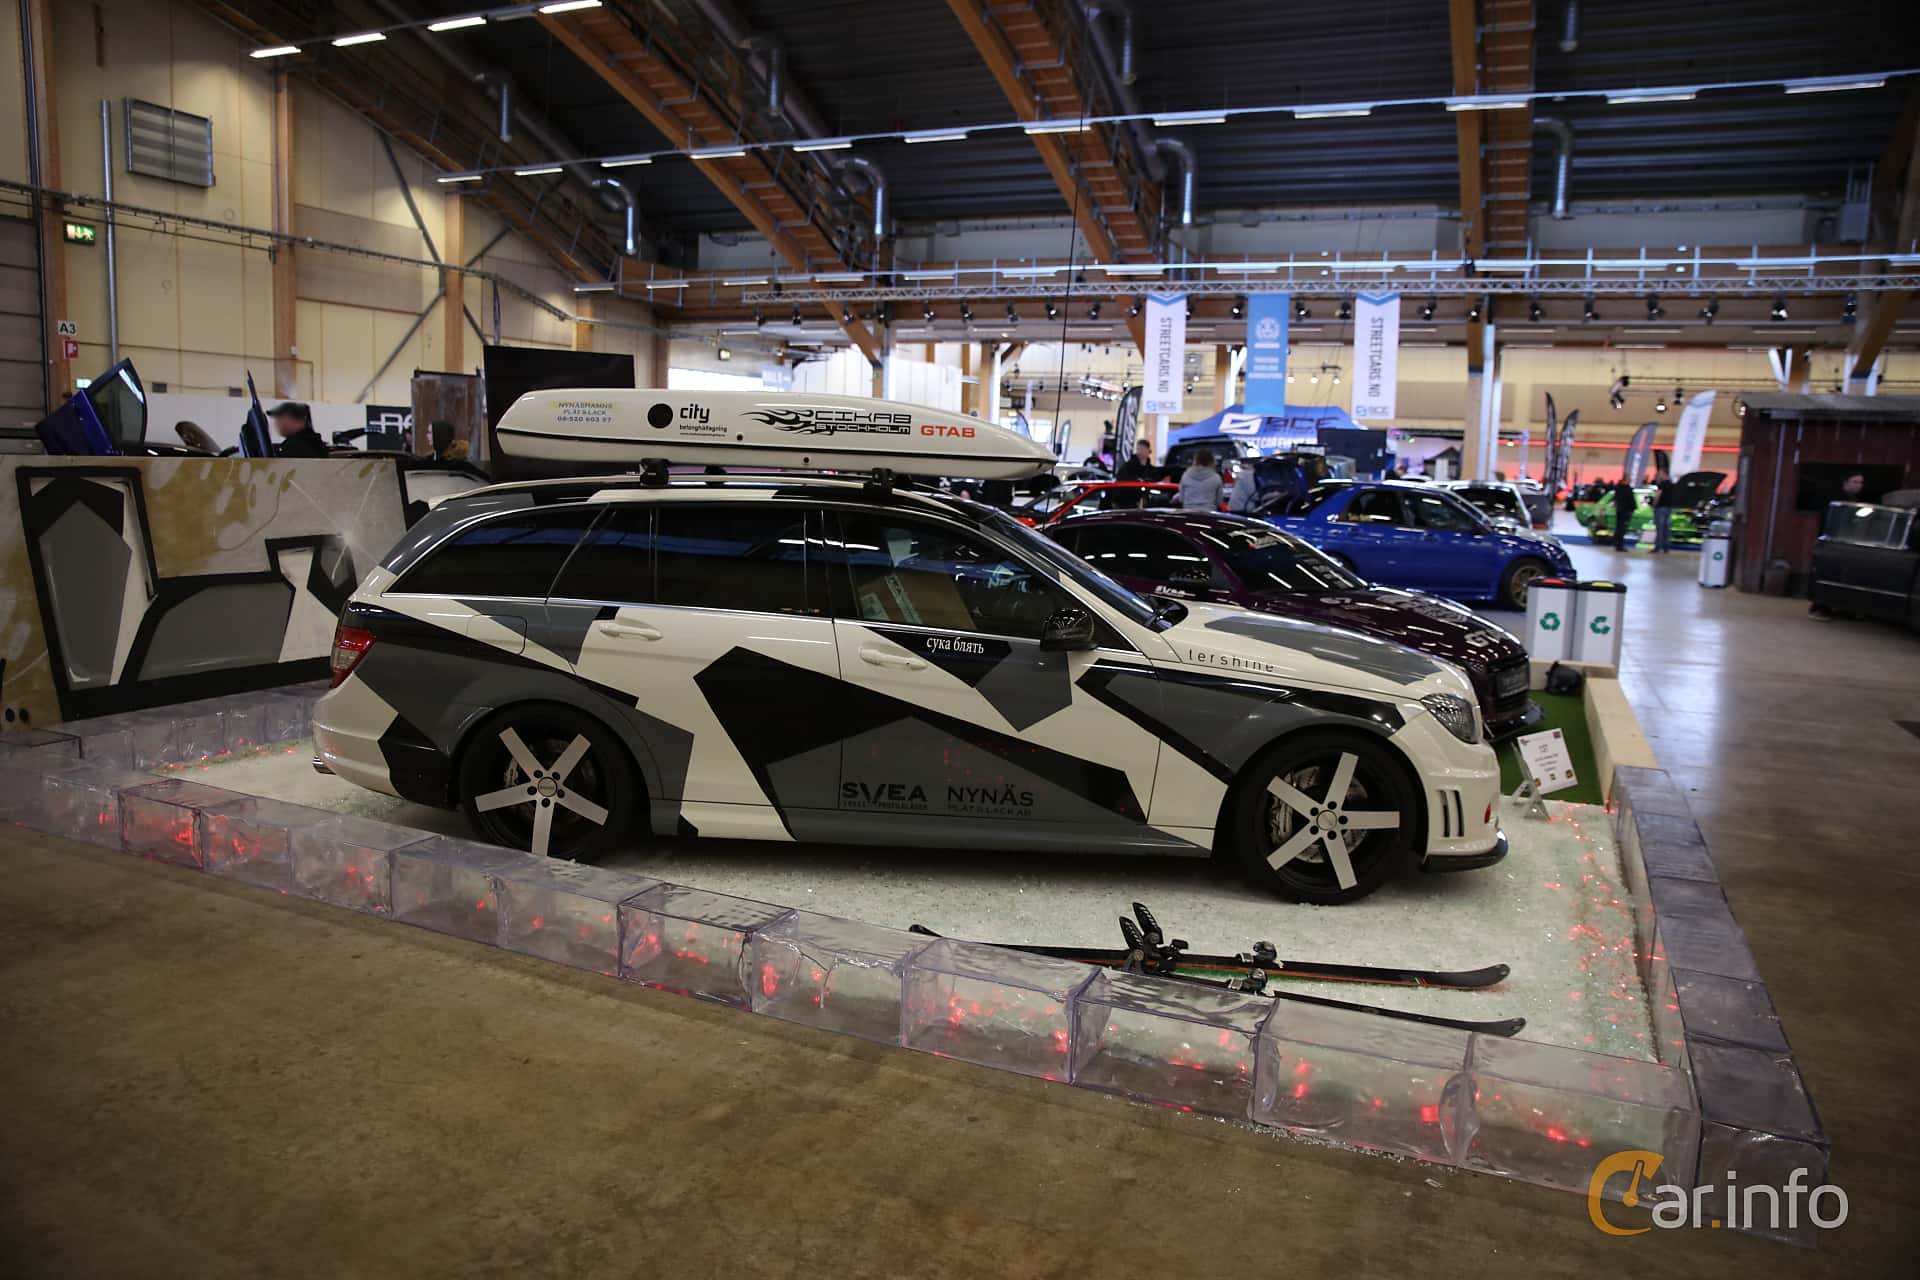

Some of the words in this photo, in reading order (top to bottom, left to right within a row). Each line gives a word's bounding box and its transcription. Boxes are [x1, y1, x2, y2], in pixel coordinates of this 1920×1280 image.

[59, 322, 76, 334] A3
[680, 403, 710, 423] city
[815, 410, 911, 424] CIKAB
[816, 423, 910, 434] STOCKHOLM
[920, 425, 975, 438] GTAB
[926, 637, 951, 653] сука
[953, 636, 985, 654] блять
[842, 782, 928, 804] SVEA
[947, 783, 1034, 807] NYNÄS
